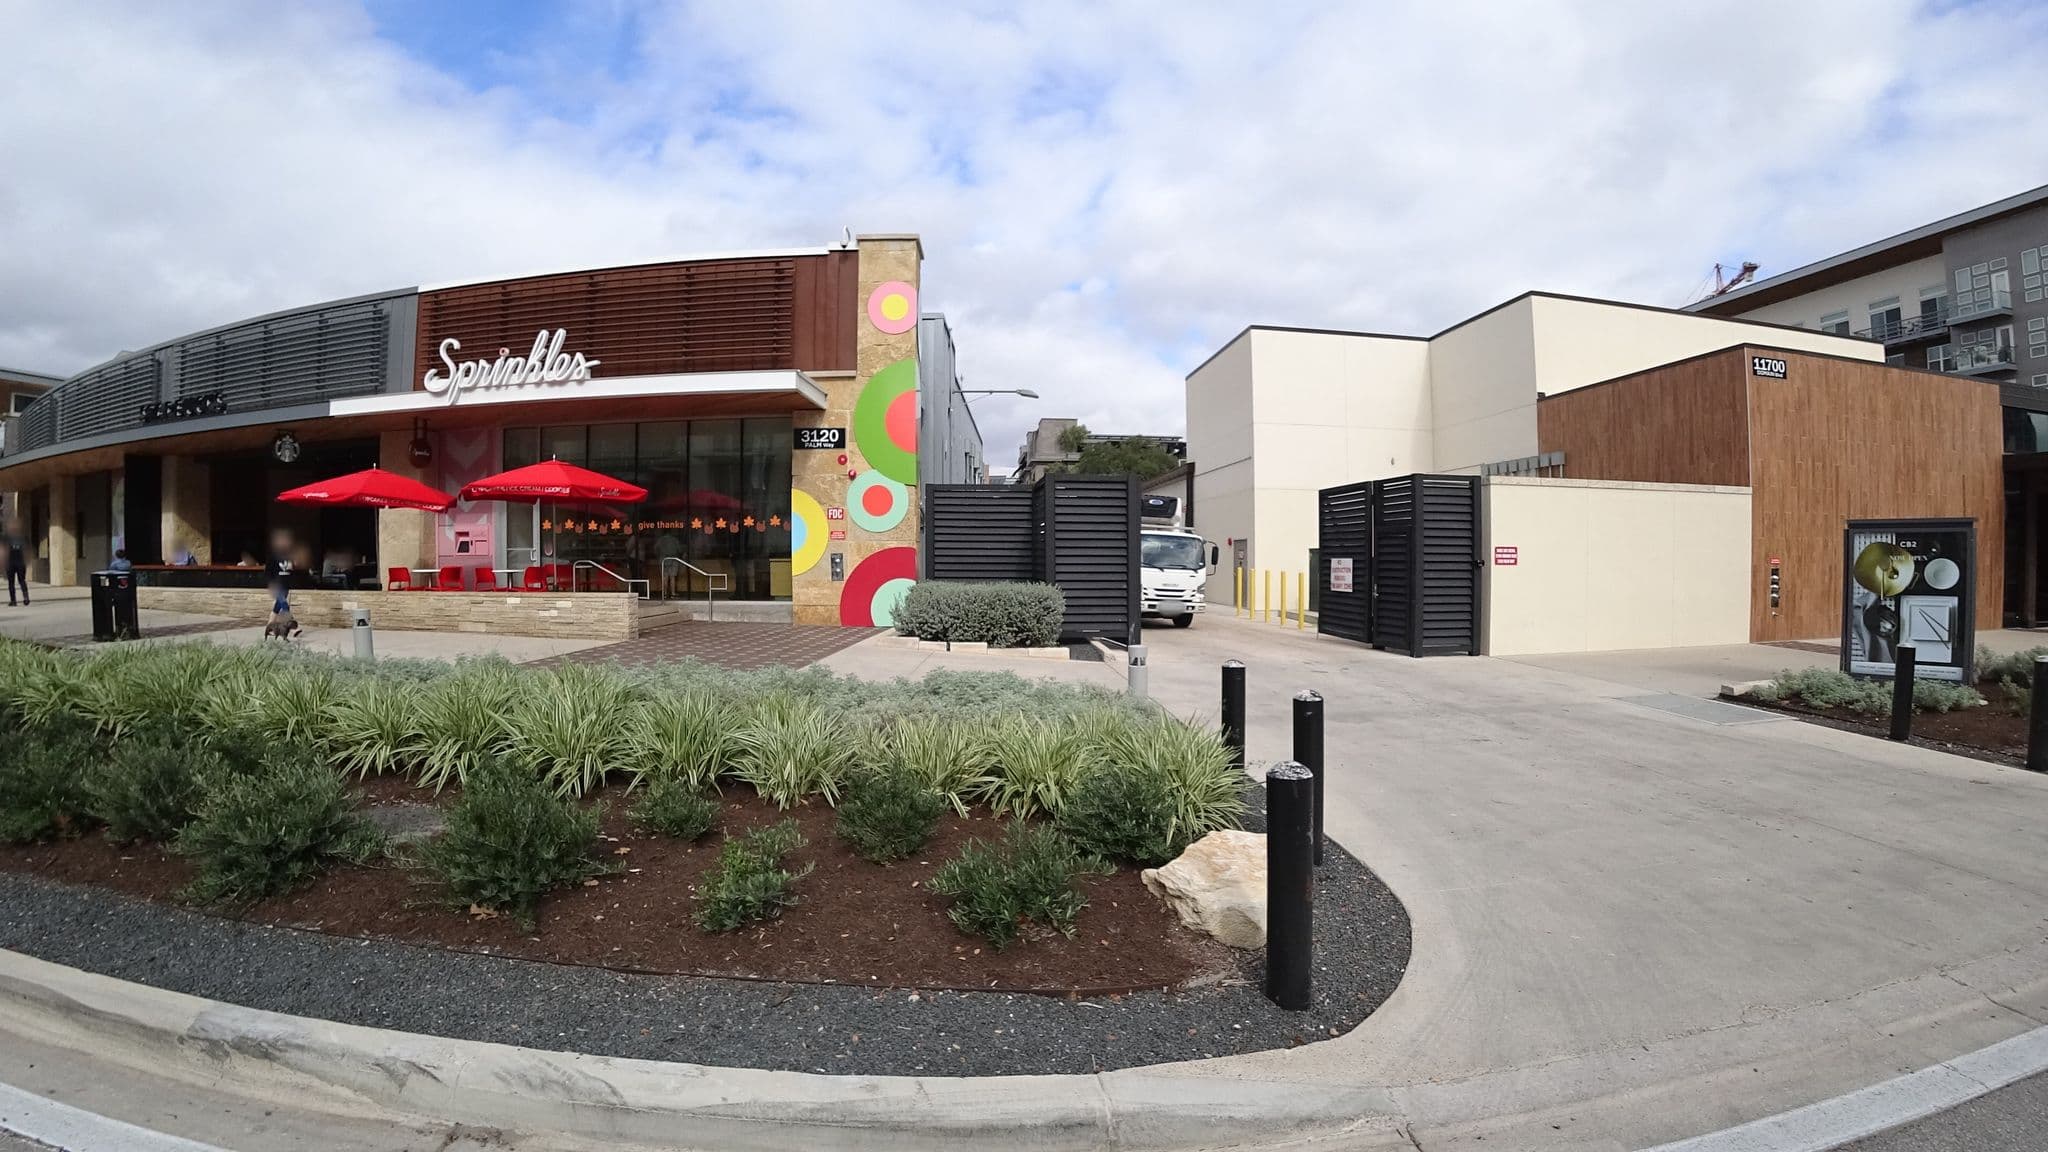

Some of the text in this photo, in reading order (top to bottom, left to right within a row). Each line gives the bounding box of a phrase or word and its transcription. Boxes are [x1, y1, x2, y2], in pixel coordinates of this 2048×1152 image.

[424, 328, 601, 405] Sprinkles
[1753, 357, 1786, 373] 11700
[801, 429, 839, 442] 3120
[828, 508, 843, 518] FDC
[638, 520, 684, 531] give thanks
